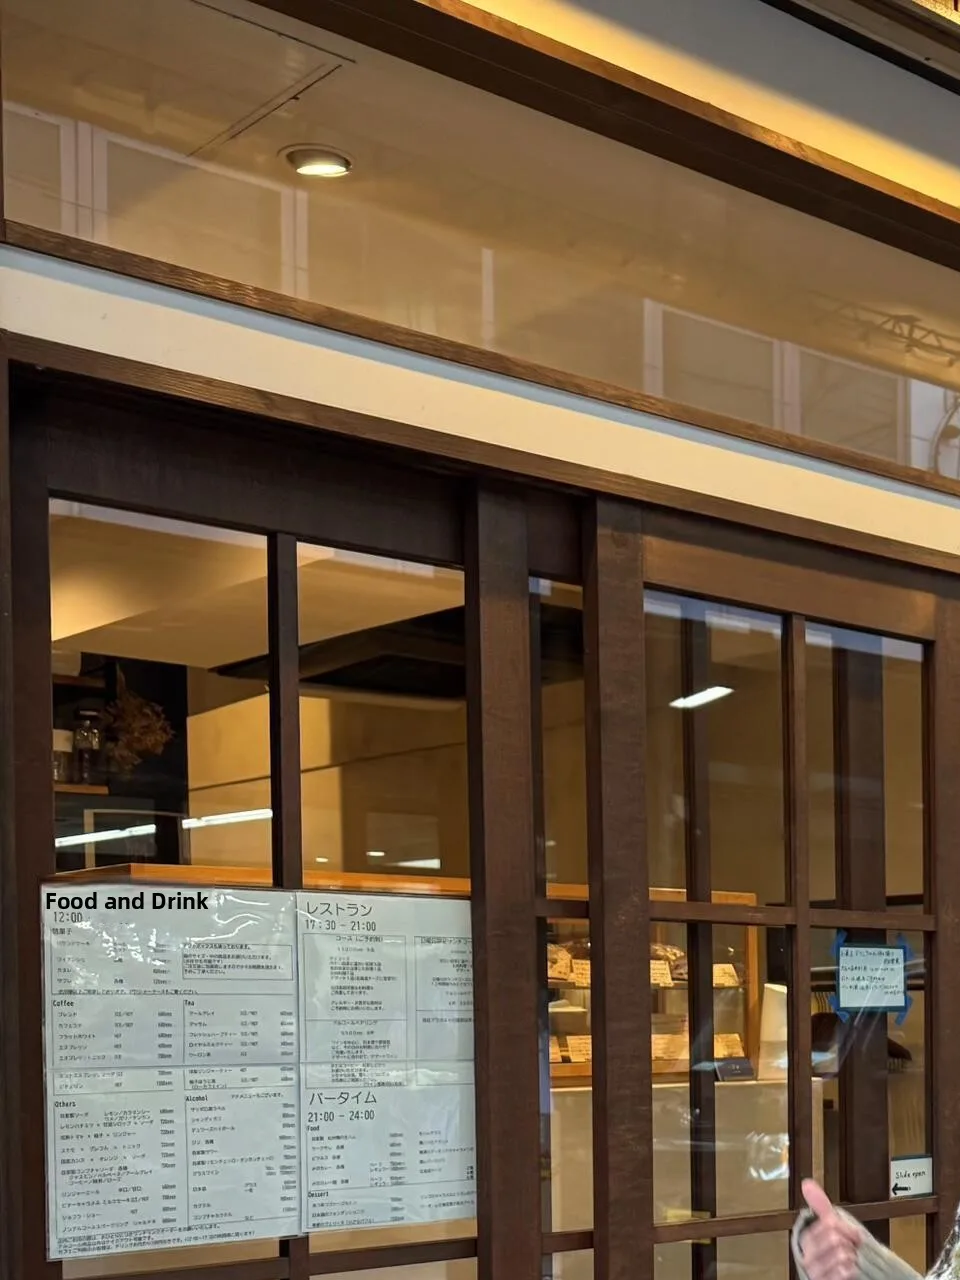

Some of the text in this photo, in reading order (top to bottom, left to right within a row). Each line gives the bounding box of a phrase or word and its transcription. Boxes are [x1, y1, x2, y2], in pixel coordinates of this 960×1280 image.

[46, 892, 209, 910] Food and Drink
[307, 901, 373, 917] レストラン
[53, 911, 83, 923] 12:00
[351, 920, 376, 932] 21:00
[309, 1091, 377, 1105] バータイム
[308, 1112, 335, 1122] 21:00
[349, 1110, 375, 1121] 24:00
